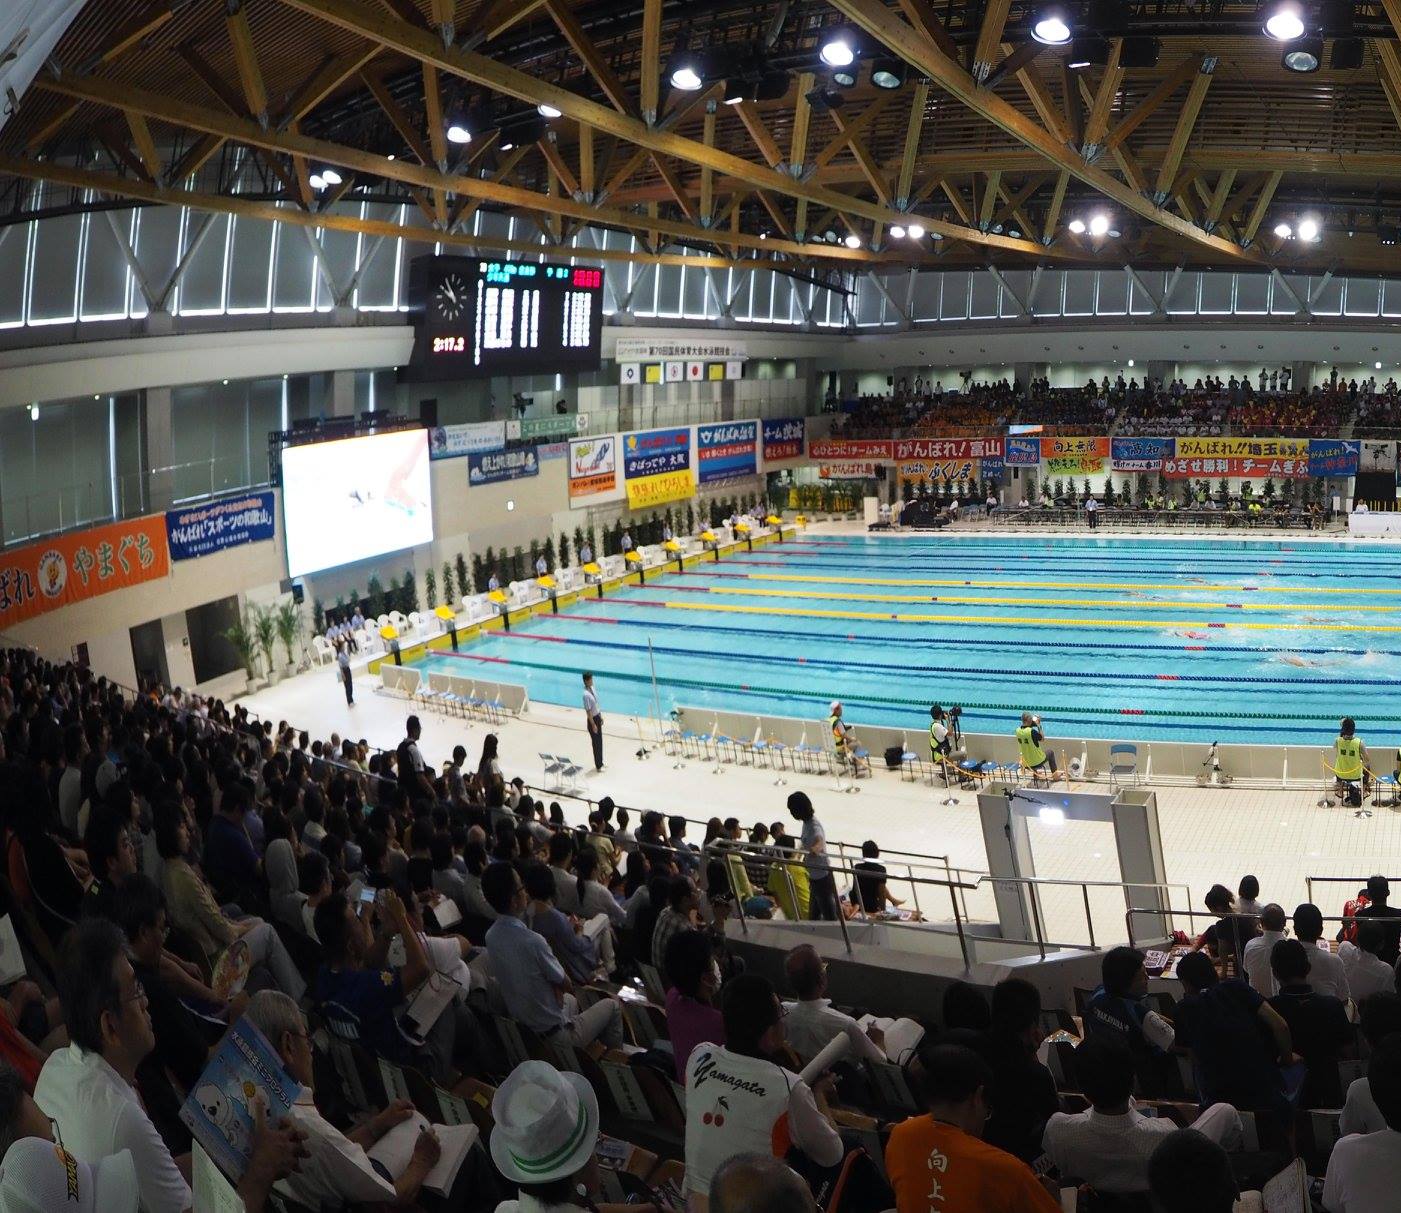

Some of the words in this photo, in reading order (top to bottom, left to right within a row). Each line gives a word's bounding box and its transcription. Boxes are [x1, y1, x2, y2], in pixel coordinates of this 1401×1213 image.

[1165, 458, 1309, 474] めざせ勝利!チームぎふ
[73, 532, 155, 586] やまぐち
[693, 1052, 767, 1097] Yamagata
[927, 1148, 948, 1213] 向上
